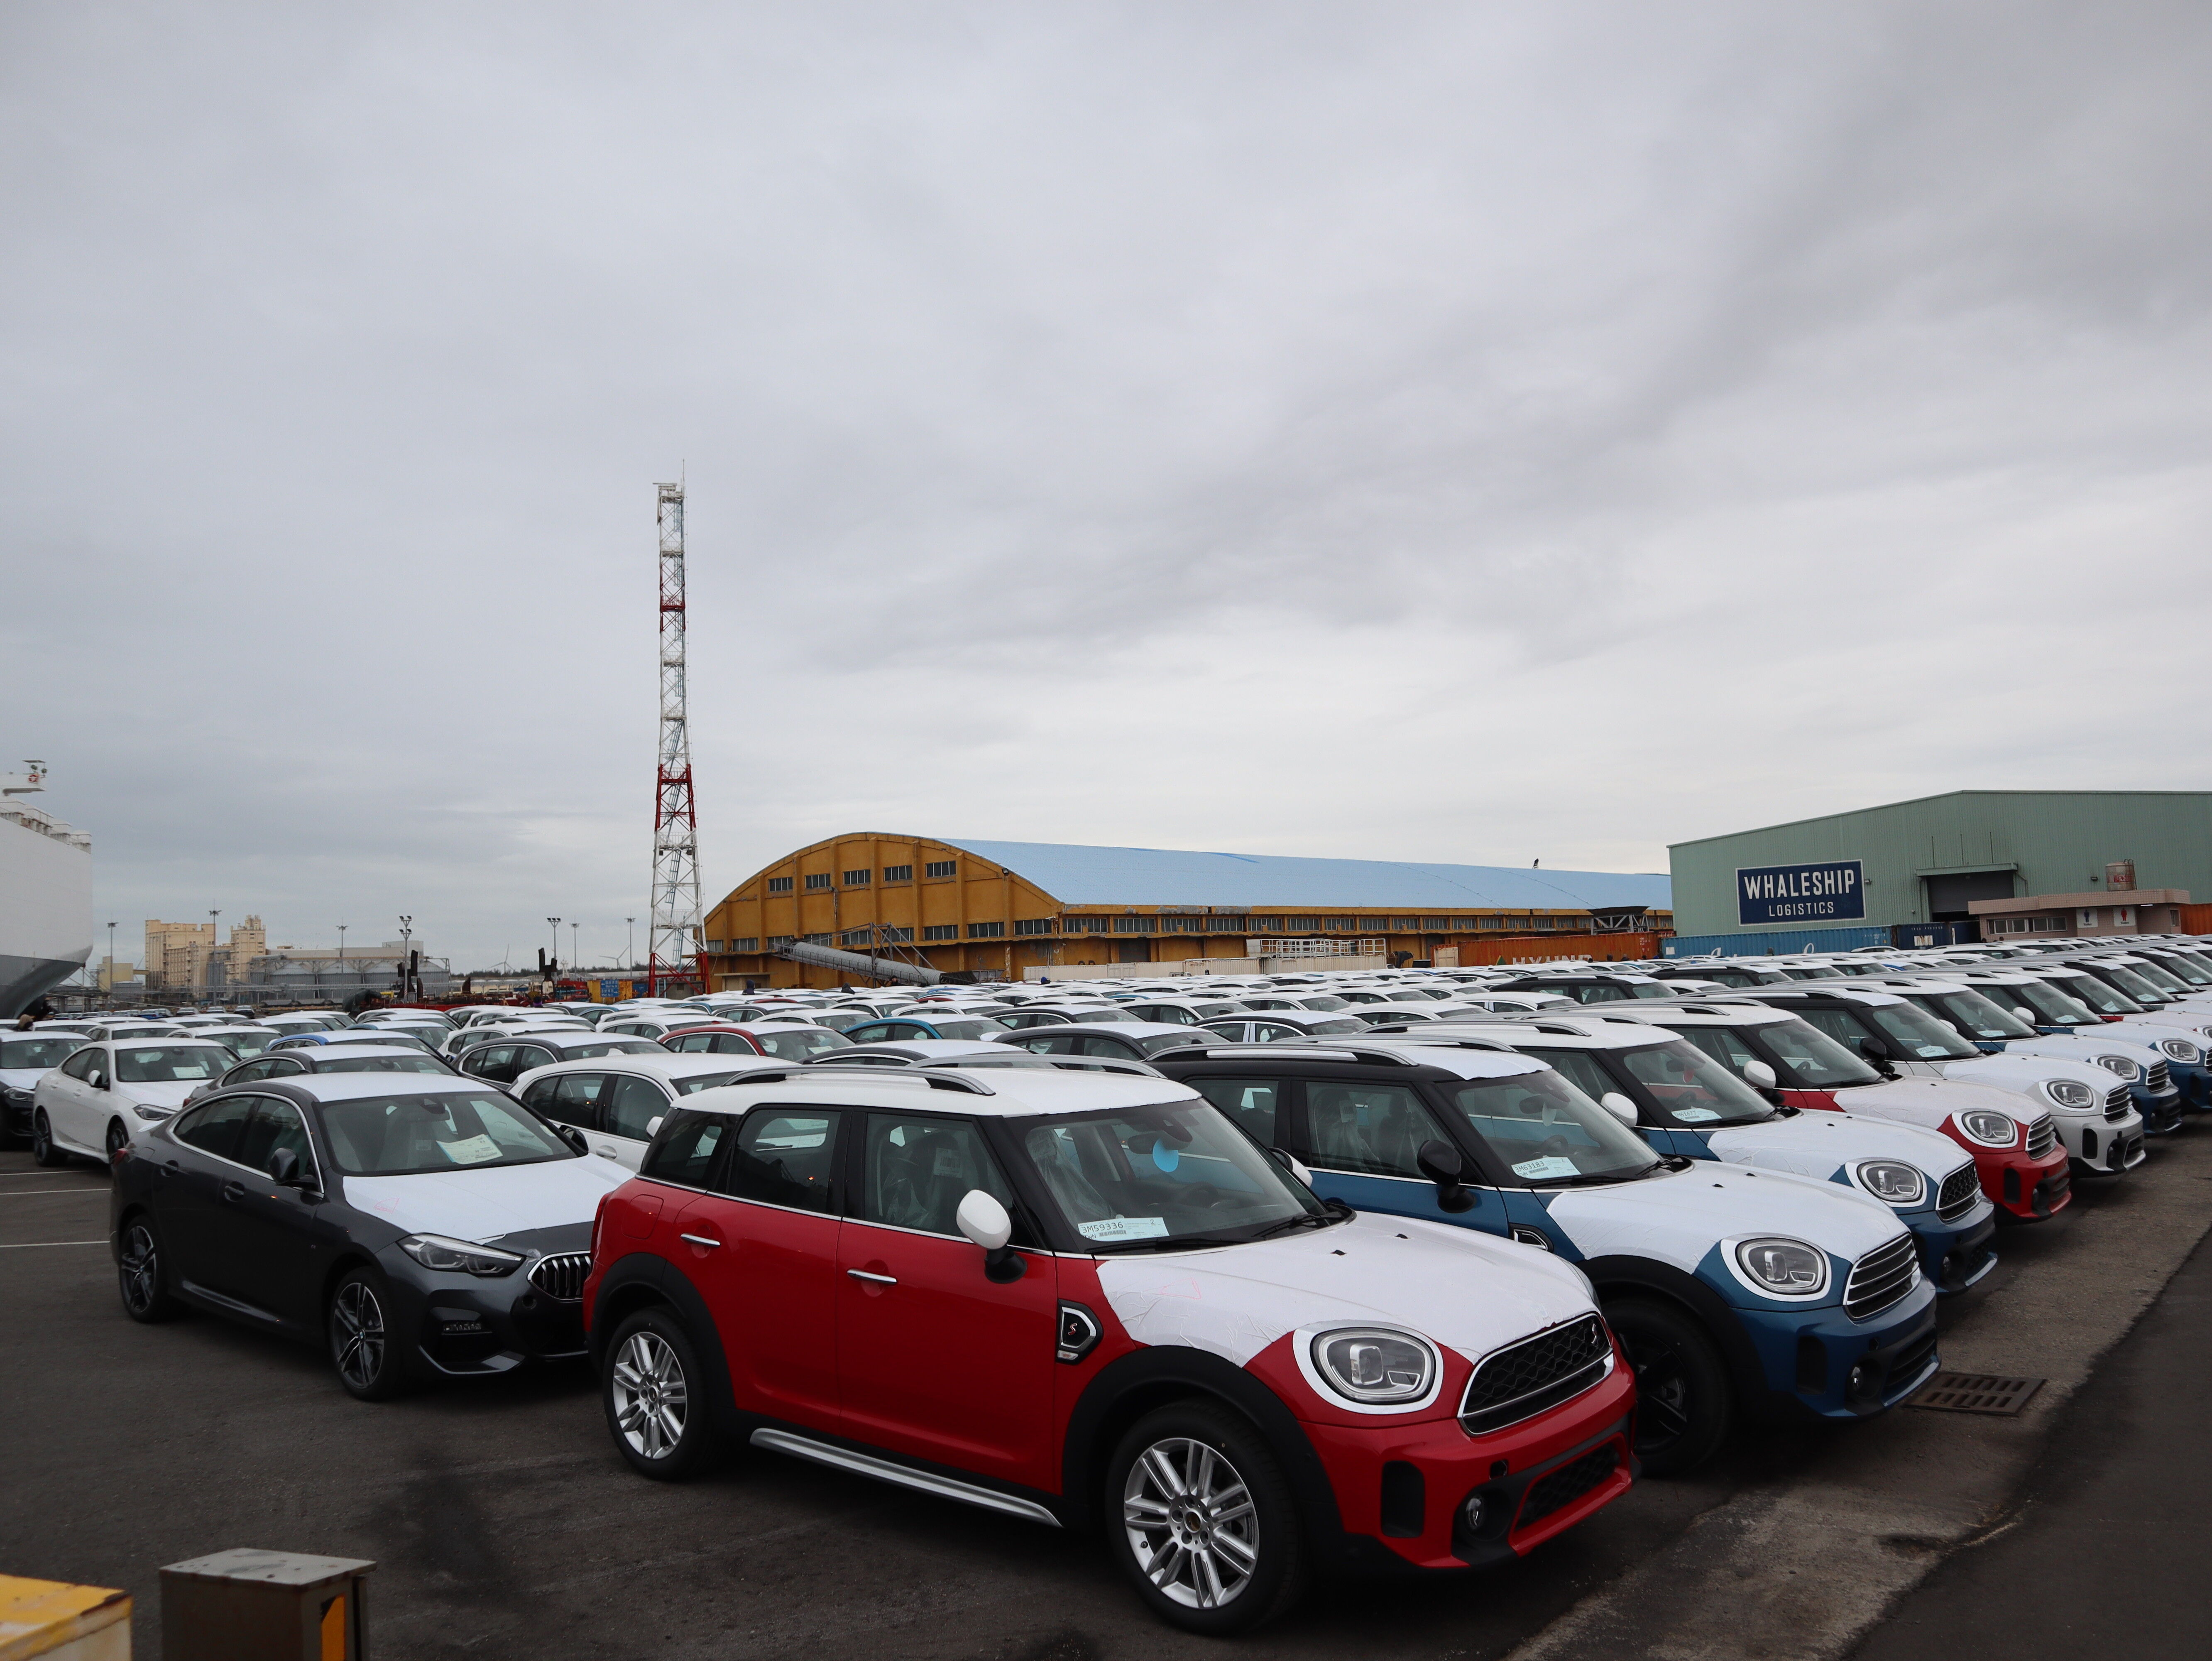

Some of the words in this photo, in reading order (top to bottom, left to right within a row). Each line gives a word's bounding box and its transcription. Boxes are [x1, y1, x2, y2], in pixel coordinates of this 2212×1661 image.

[1744, 869, 1855, 899] WHALESHIP
[1769, 902, 1834, 917] LOGISTICS
[1515, 1161, 1545, 1173] 3M63183
[1081, 1222, 1123, 1233] 3M59336
